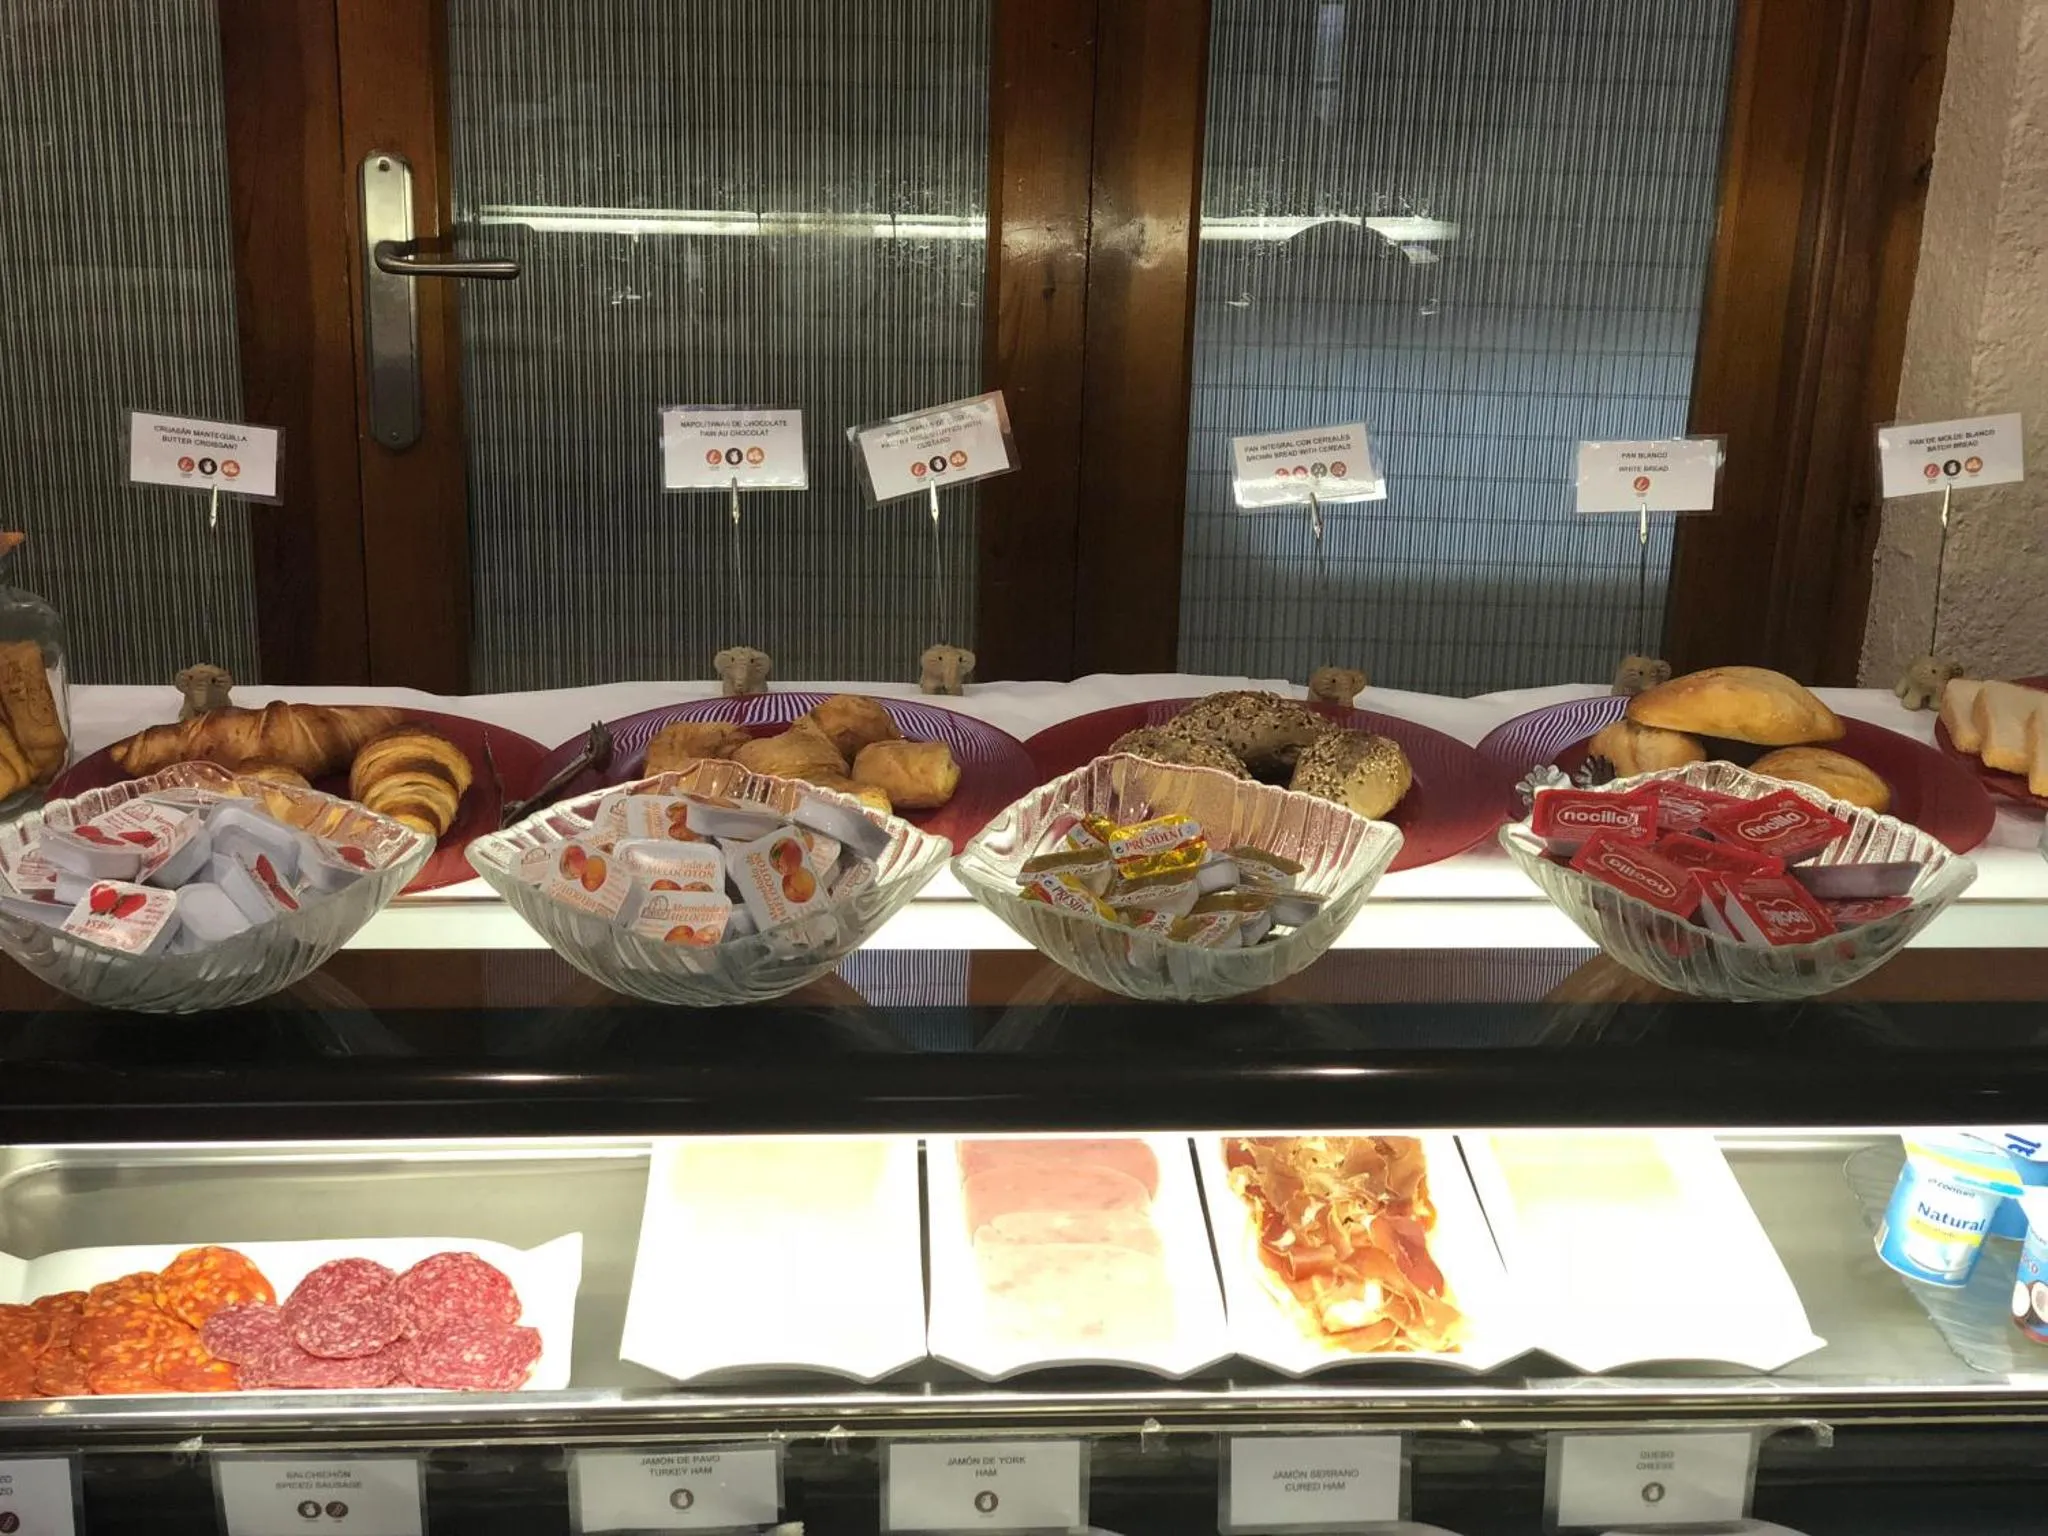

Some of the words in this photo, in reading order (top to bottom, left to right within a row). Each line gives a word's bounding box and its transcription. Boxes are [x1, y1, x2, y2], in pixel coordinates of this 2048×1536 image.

[193, 430, 247, 442] MANTEQUILLA
[1965, 429, 1995, 439] BLANCO
[162, 435, 192, 445] BUTTER
[194, 439, 238, 450] CROISSANT
[1260, 441, 1294, 450] INTEGRAL
[1296, 438, 1312, 446] CON
[1313, 433, 1350, 445] CEREALES
[1953, 440, 1979, 449] BREAD
[1246, 453, 1273, 462] BROWN
[1274, 450, 1298, 459] BREAD
[1300, 448, 1317, 456] WITH
[1319, 443, 1351, 454] CEREALS
[1564, 811, 1629, 825] nocilla
[1744, 812, 1801, 837] nocilla
[1608, 857, 1671, 894] nocilla
[1917, 1201, 1986, 1232] Natural
[676, 1455, 690, 1465] DE
[692, 1455, 720, 1464] PAVO
[948, 1455, 980, 1466] JAMÓN
[982, 1456, 996, 1465] DE
[999, 1456, 1026, 1465] YORK
[1639, 1450, 1674, 1460] QUESO
[1636, 1461, 1675, 1470] CHEESE
[650, 1467, 688, 1476] TURKEY
[690, 1467, 712, 1475] HAM
[975, 1468, 998, 1477] HAM
[1309, 1468, 1359, 1478] SERRANO
[275, 1482, 313, 1490] SPICED
[315, 1481, 361, 1489] SAUSAGE
[1284, 1482, 1321, 1492] CURED
[1322, 1481, 1346, 1491] HAM
